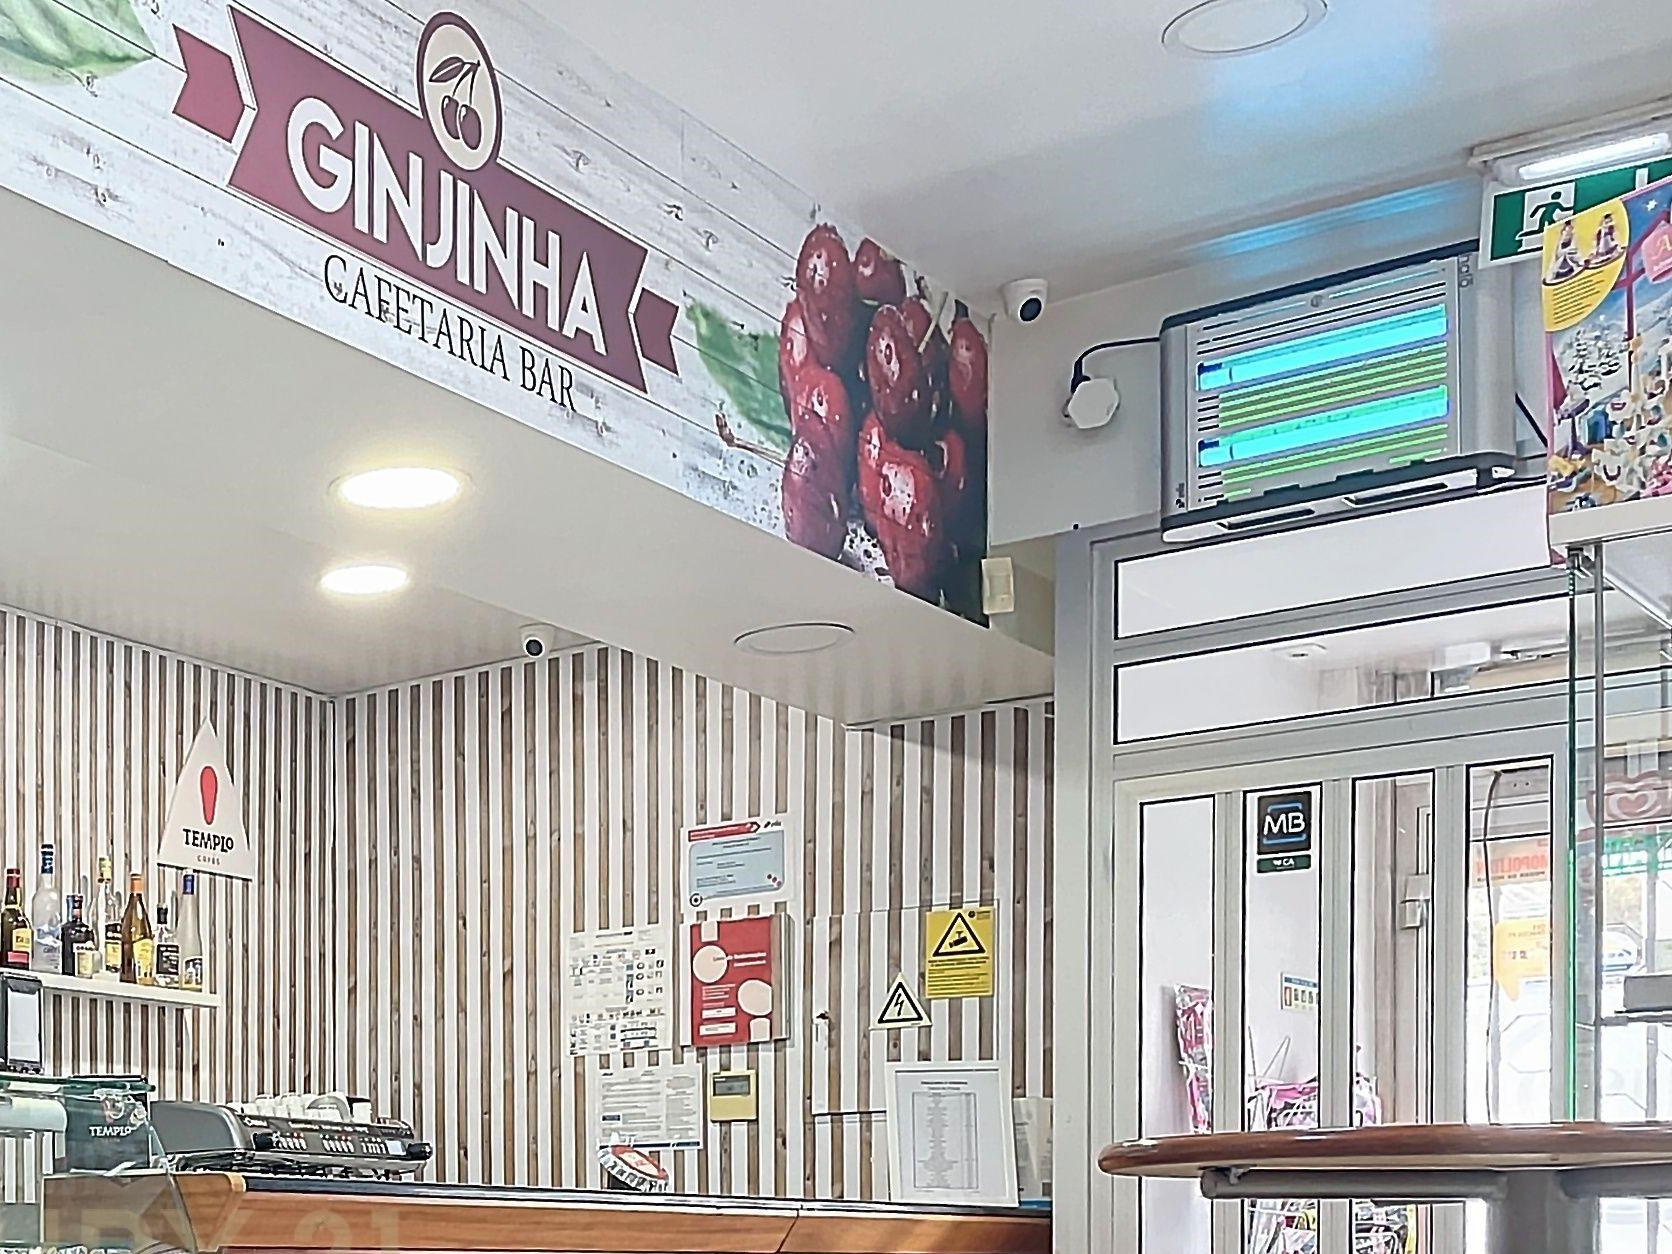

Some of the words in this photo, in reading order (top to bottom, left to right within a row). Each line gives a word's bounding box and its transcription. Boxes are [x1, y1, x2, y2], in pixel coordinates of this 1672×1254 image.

[287, 97, 607, 355] GINJINHA
[322, 254, 510, 382] CAFETARIA
[520, 347, 578, 414] BAR
[1264, 811, 1306, 835] MB
[182, 828, 234, 852] TEMPLO
[89, 1126, 133, 1137] TEMPLO
